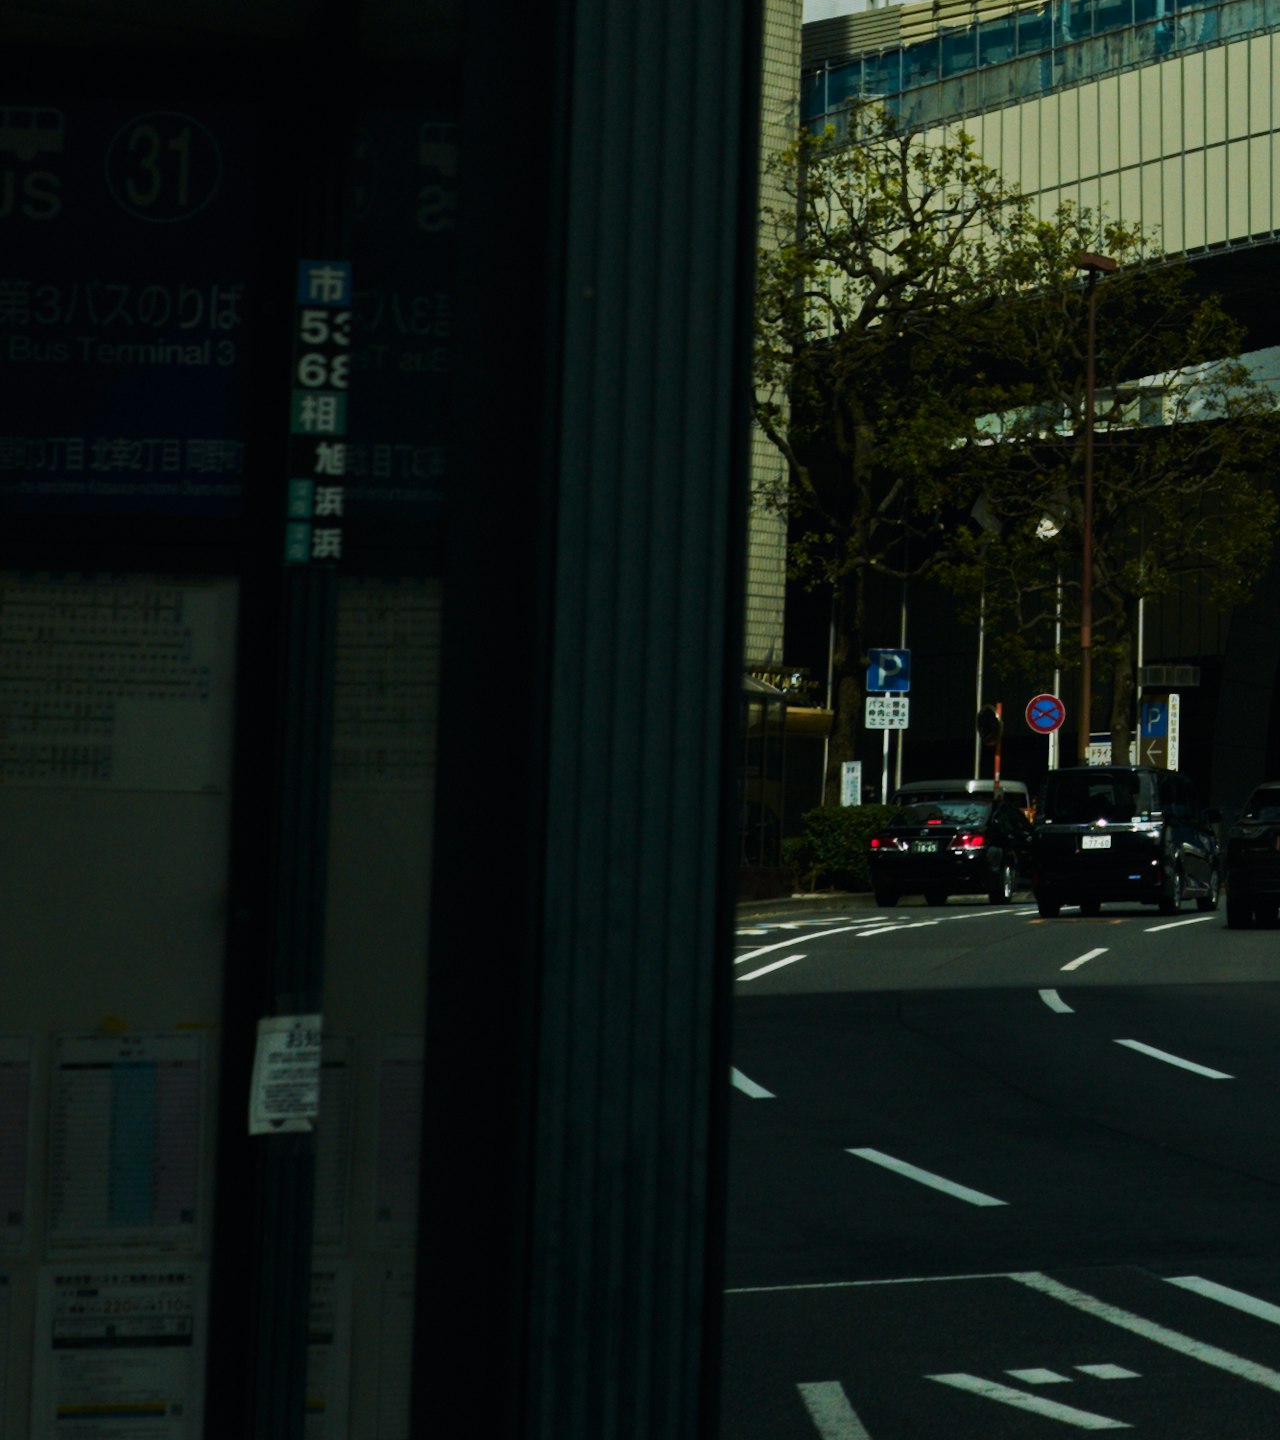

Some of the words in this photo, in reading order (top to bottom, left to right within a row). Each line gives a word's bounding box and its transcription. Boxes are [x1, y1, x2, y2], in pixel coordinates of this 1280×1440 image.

[126, 124, 192, 207] 31
[308, 266, 346, 302] 市
[9, 336, 69, 361] Bus
[77, 337, 211, 366] Terminal
[217, 340, 237, 366] 3
[299, 396, 338, 432] 相
[313, 441, 345, 476] 旭
[877, 653, 903, 687] P
[1148, 707, 1161, 733] P
